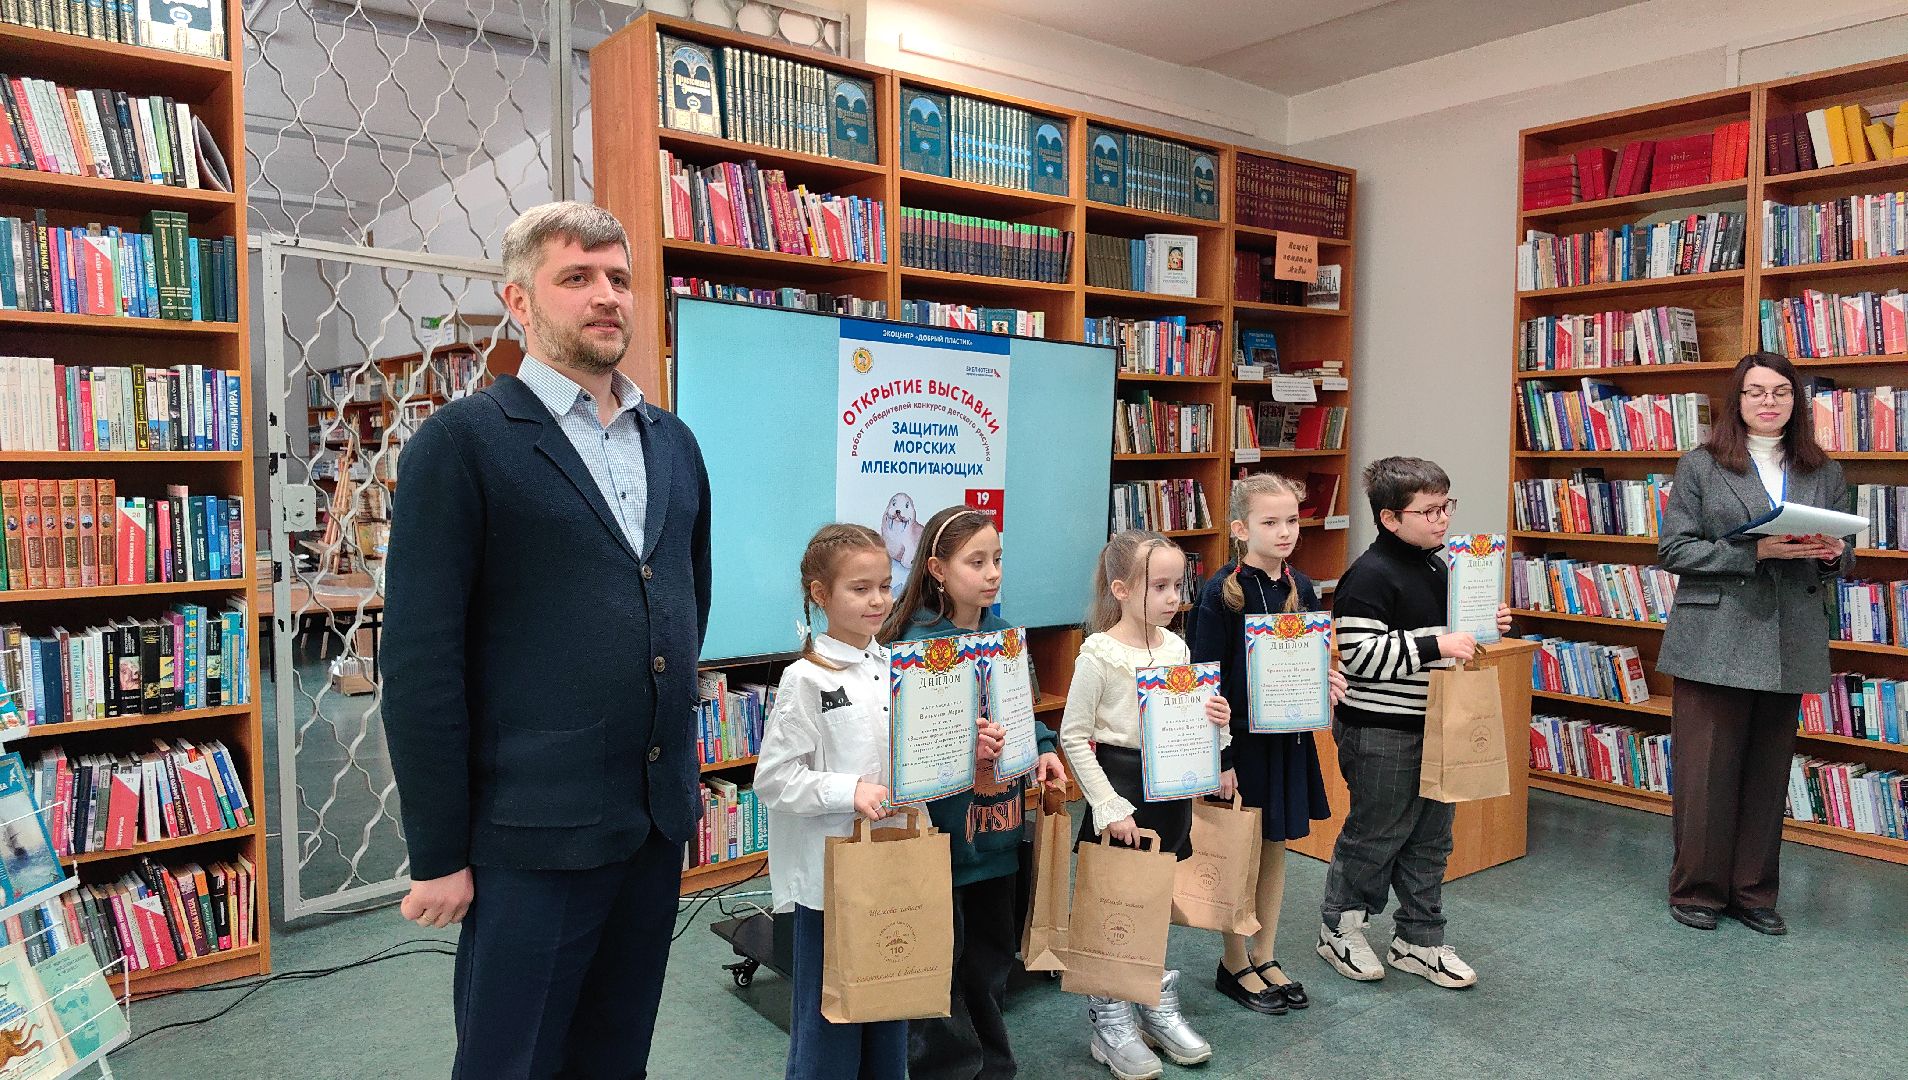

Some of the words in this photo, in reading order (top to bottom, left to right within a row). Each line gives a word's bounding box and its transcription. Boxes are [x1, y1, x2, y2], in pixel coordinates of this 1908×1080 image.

[95, 252, 103, 271] науки
[94, 272, 105, 308] Химические
[883, 330, 914, 340] ЭКОЦЕНТР
[915, 333, 944, 343] «ДОБРЫЙ
[945, 337, 973, 346] ПЛАСТИК»
[228, 389, 239, 416] МИРА
[843, 379, 922, 426] ОТКРЫТИЕ
[928, 380, 1000, 434] ВЫСТАВКИ
[230, 417, 239, 446] СТРАНЫ
[851, 430, 865, 457] работ
[865, 402, 912, 429] победителей
[913, 402, 946, 412] конкурса
[947, 407, 976, 429] детского
[975, 428, 991, 462] рисунка
[891, 422, 959, 438] ЗАЩИТИМ
[893, 440, 956, 455] МОРСКИХ
[861, 461, 984, 478] МЛЕКОПИТАЮЩИХ
[976, 491, 990, 506] 19
[230, 528, 241, 566] ЗООЛОГИЯ
[127, 542, 135, 582] Биологические
[115, 816, 125, 846] Энергетика
[743, 800, 753, 852] Справочник
[890, 945, 904, 955] 110
